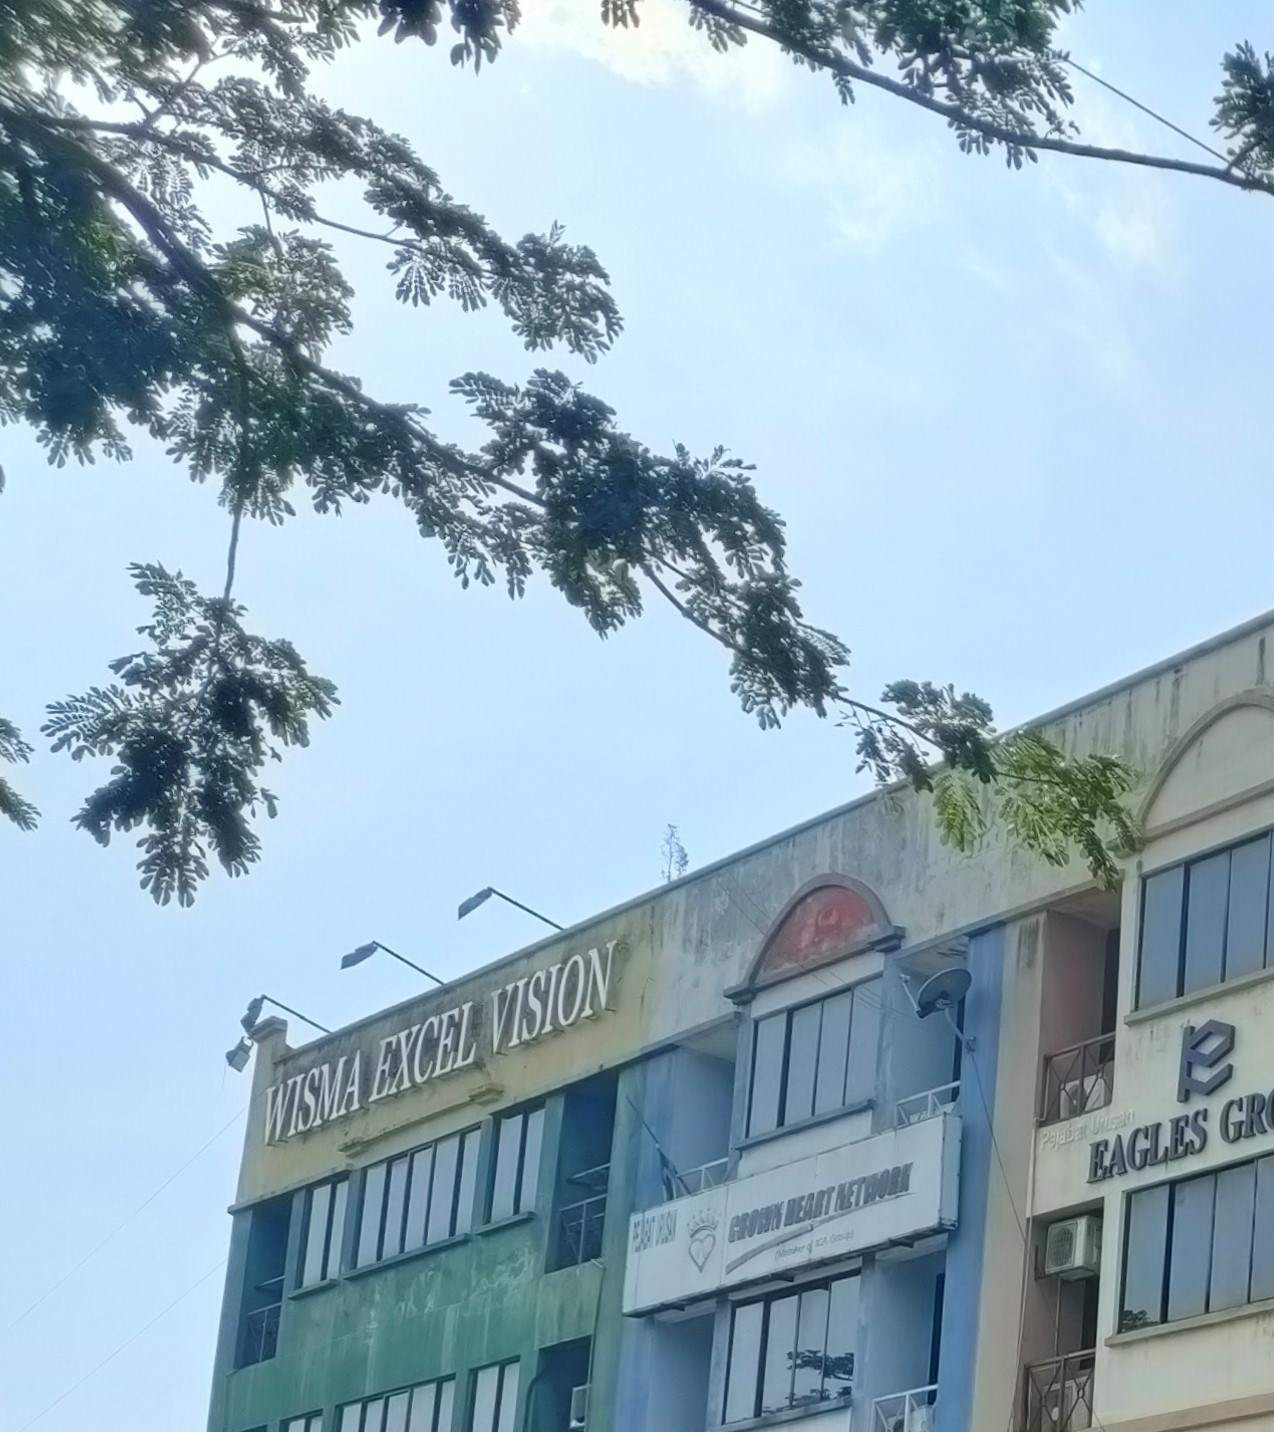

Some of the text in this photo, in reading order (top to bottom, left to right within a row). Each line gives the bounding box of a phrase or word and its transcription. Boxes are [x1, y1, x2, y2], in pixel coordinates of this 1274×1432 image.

[263, 940, 619, 1146] WISMA EXCEL VISION
[1086, 1107, 1209, 1184] EAGLES
